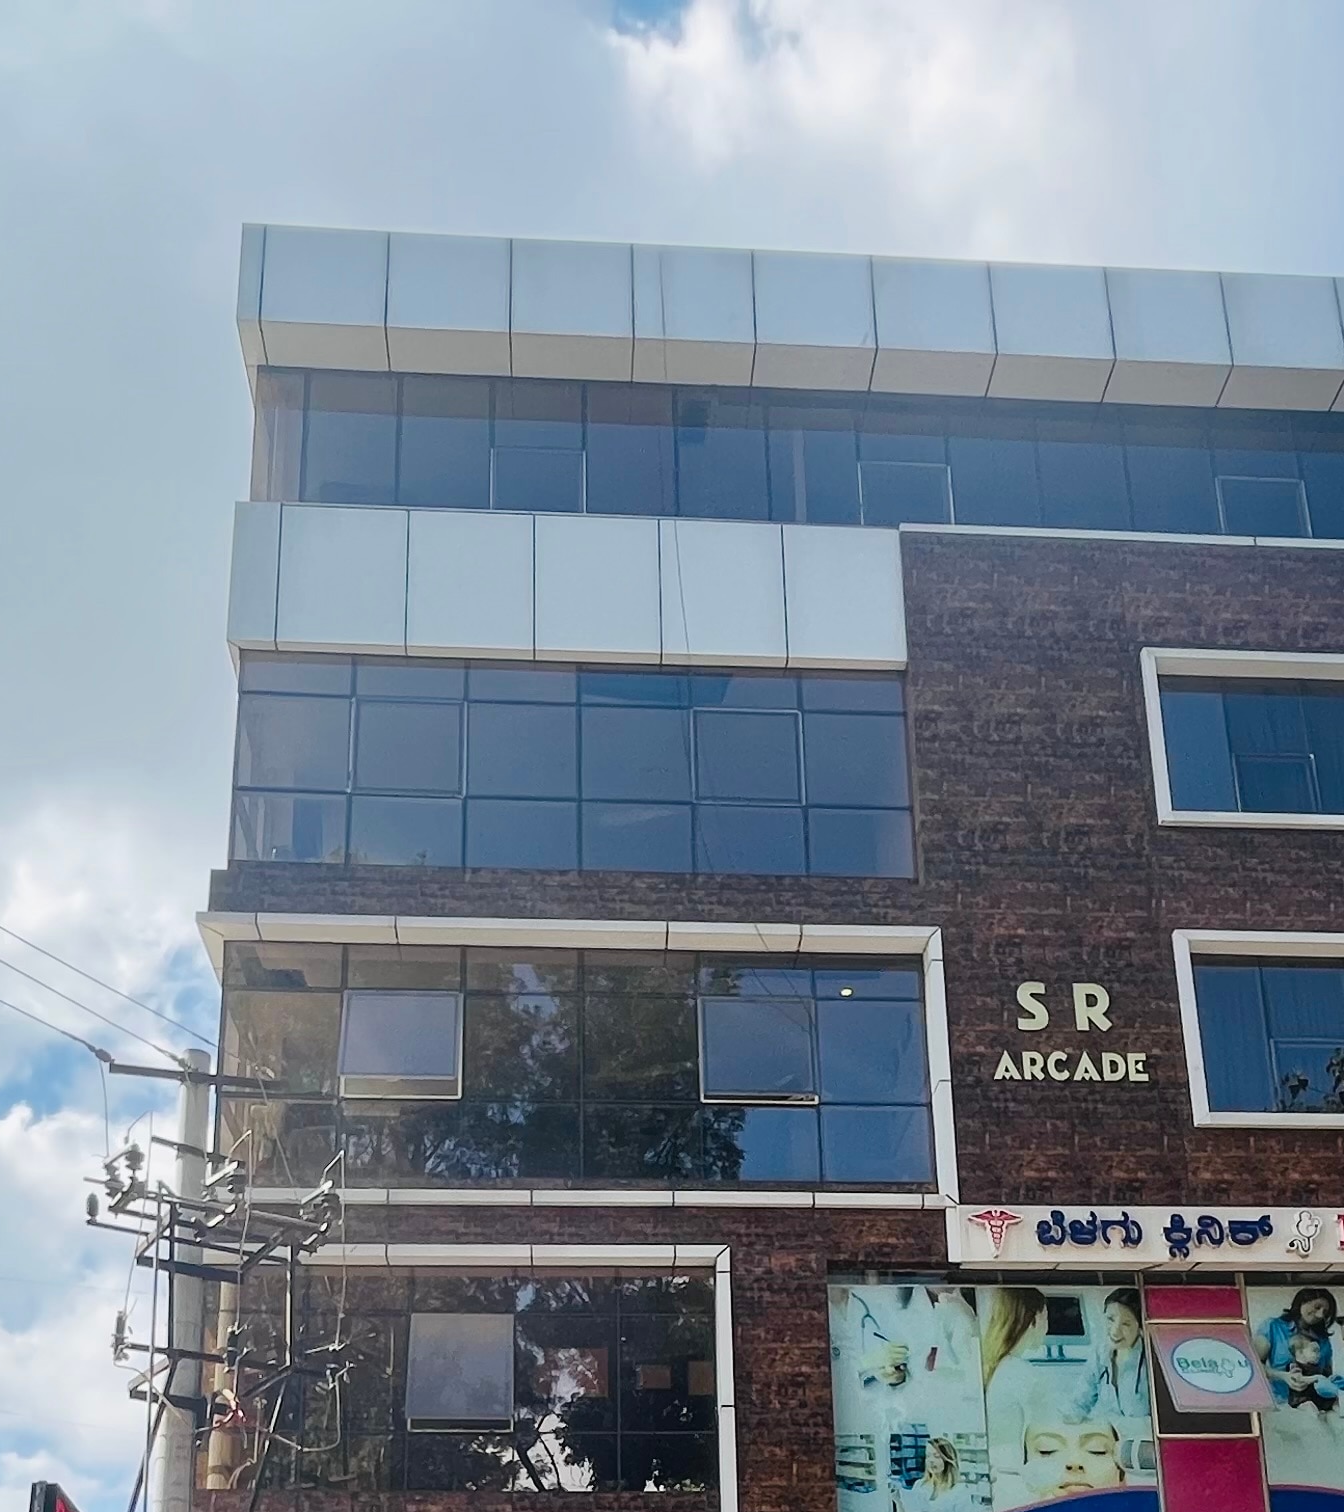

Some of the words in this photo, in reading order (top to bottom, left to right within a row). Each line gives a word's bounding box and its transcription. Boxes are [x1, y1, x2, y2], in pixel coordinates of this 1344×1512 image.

[1016, 981, 1050, 1031] S
[1072, 982, 1113, 1032] R
[993, 1050, 1150, 1082] ARCADE
